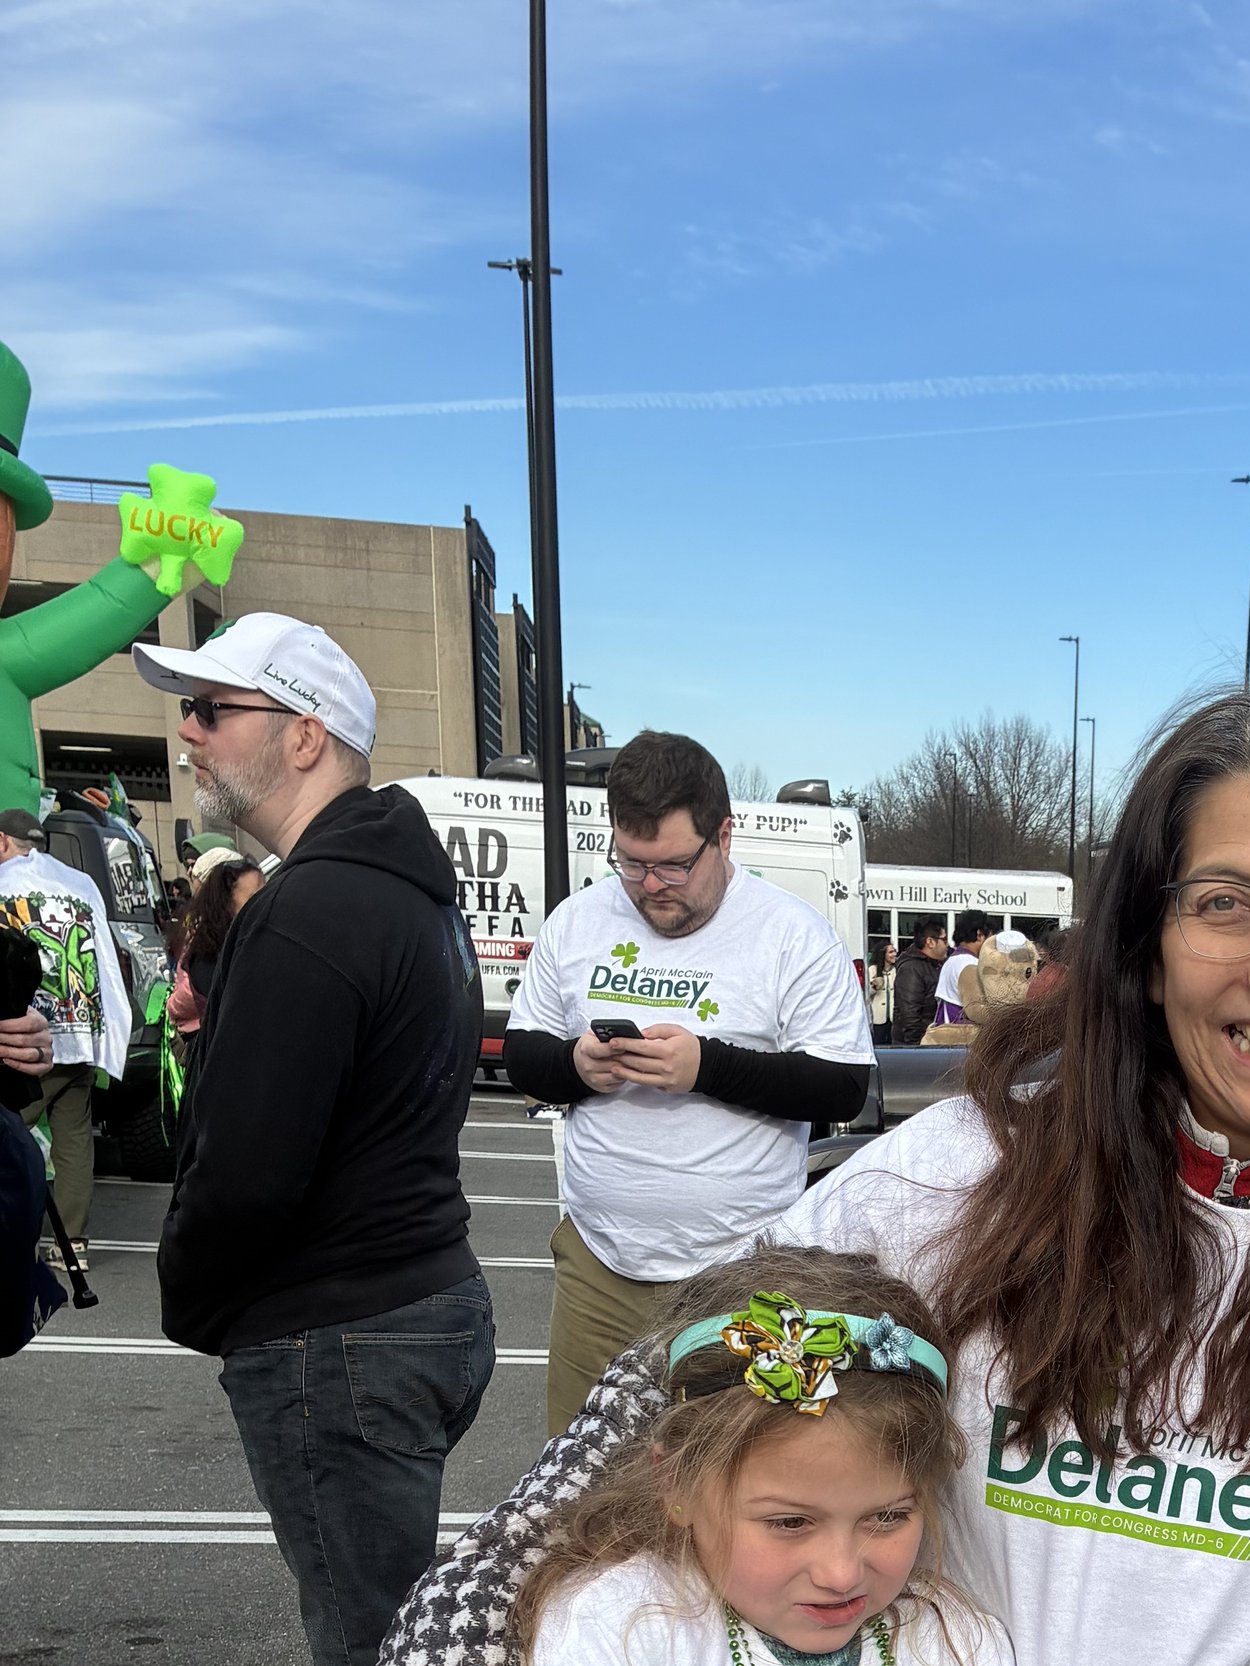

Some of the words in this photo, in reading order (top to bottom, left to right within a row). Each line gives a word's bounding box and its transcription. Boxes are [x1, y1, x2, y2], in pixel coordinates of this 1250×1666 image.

[129, 507, 224, 548] LUCKY
[263, 663, 288, 686] Live
[288, 681, 322, 712] Lucky
[566, 799, 592, 816] AD
[433, 826, 508, 879] AD
[576, 831, 616, 853] 202
[900, 886, 927, 902] Hill
[933, 887, 972, 908] Early
[976, 889, 1027, 906] School
[589, 965, 710, 1009] Delaney
[639, 966, 667, 977] April
[668, 968, 714, 979] McClain
[993, 1491, 1071, 1521] DEMOCRAT
[1074, 1509, 1099, 1525] FOR
[1100, 1514, 1178, 1542] CONGRESS
[1182, 1530, 1225, 1550] MD-6
